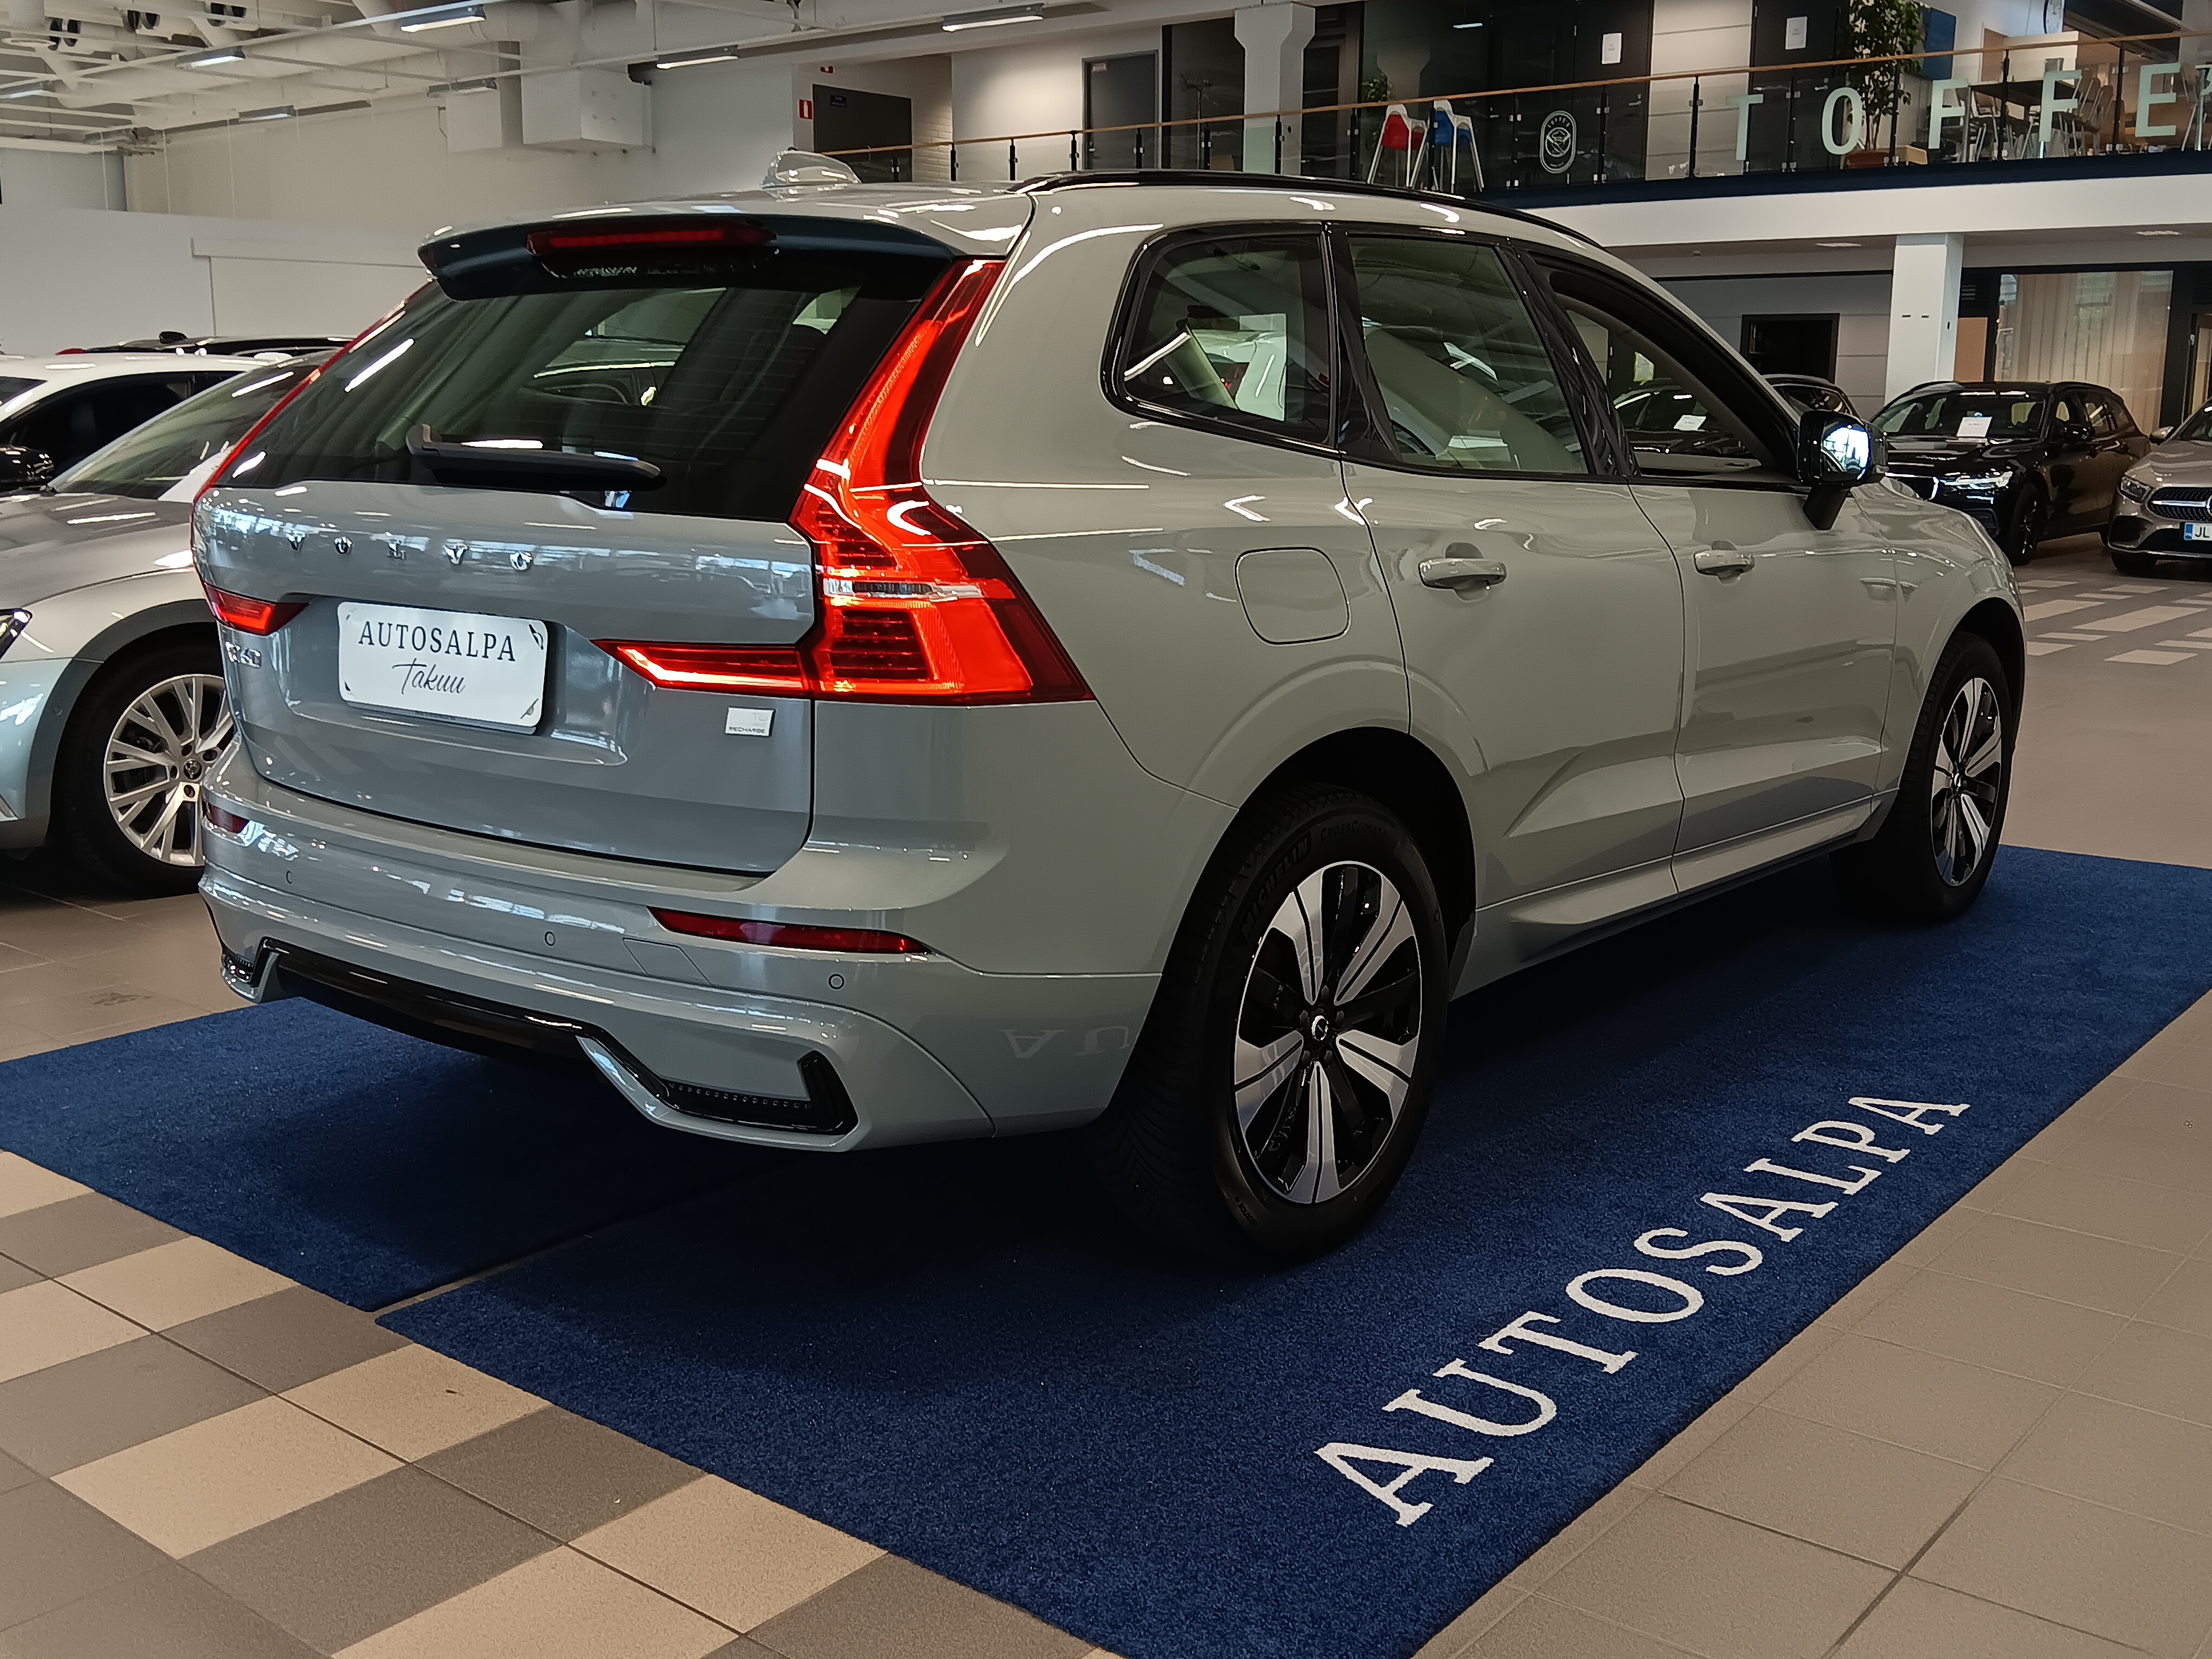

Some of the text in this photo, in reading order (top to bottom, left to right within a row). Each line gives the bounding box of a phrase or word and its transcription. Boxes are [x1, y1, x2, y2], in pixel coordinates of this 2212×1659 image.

[285, 530, 533, 571] VOLVO
[358, 620, 516, 662] AUTOSALPA
[392, 658, 466, 695] Takuu
[1242, 838, 1308, 938] MICHELIN
[1313, 1097, 1971, 1528] AUTOSALPA
